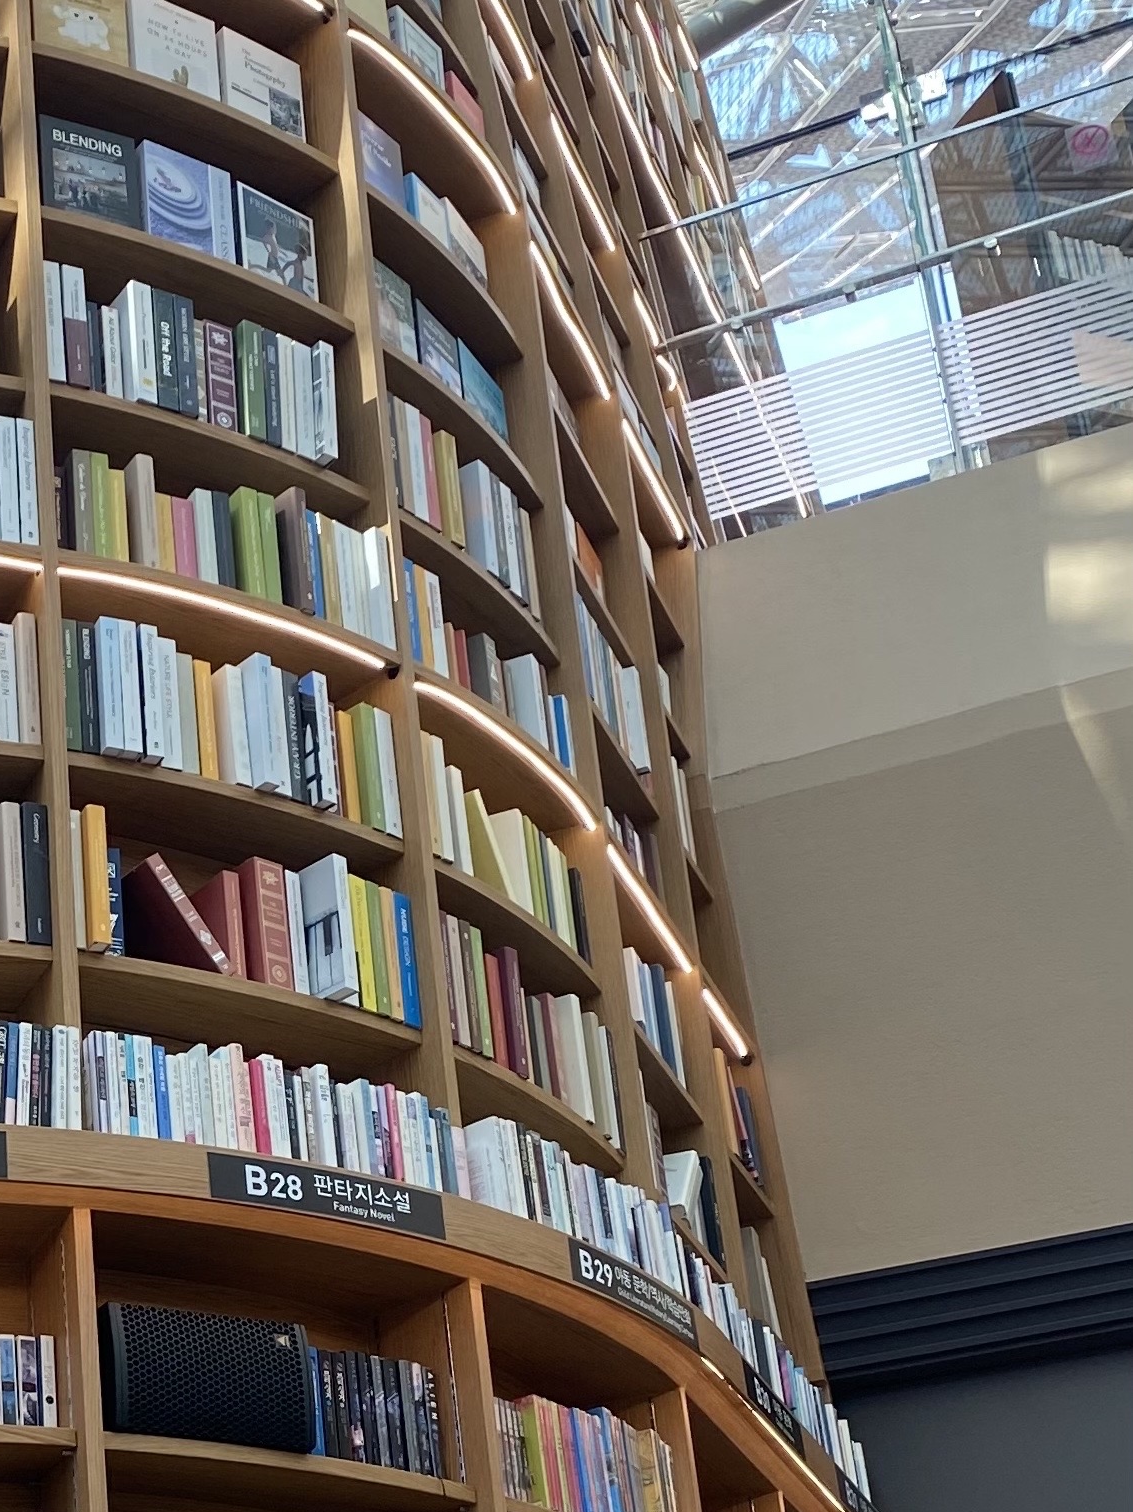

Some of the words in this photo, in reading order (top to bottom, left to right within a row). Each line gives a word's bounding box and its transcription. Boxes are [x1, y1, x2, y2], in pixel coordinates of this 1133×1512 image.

[52, 128, 122, 157] BLENDING
[161, 321, 170, 337] Off
[162, 353, 172, 376] Road
[244, 1164, 303, 1200] B28
[313, 1174, 412, 1214] 판타지소설
[333, 1201, 368, 1218] Fantasy
[370, 1208, 396, 1222] Novel
[579, 1248, 613, 1288] B29
[426, 1371, 439, 1421] ALIEN
